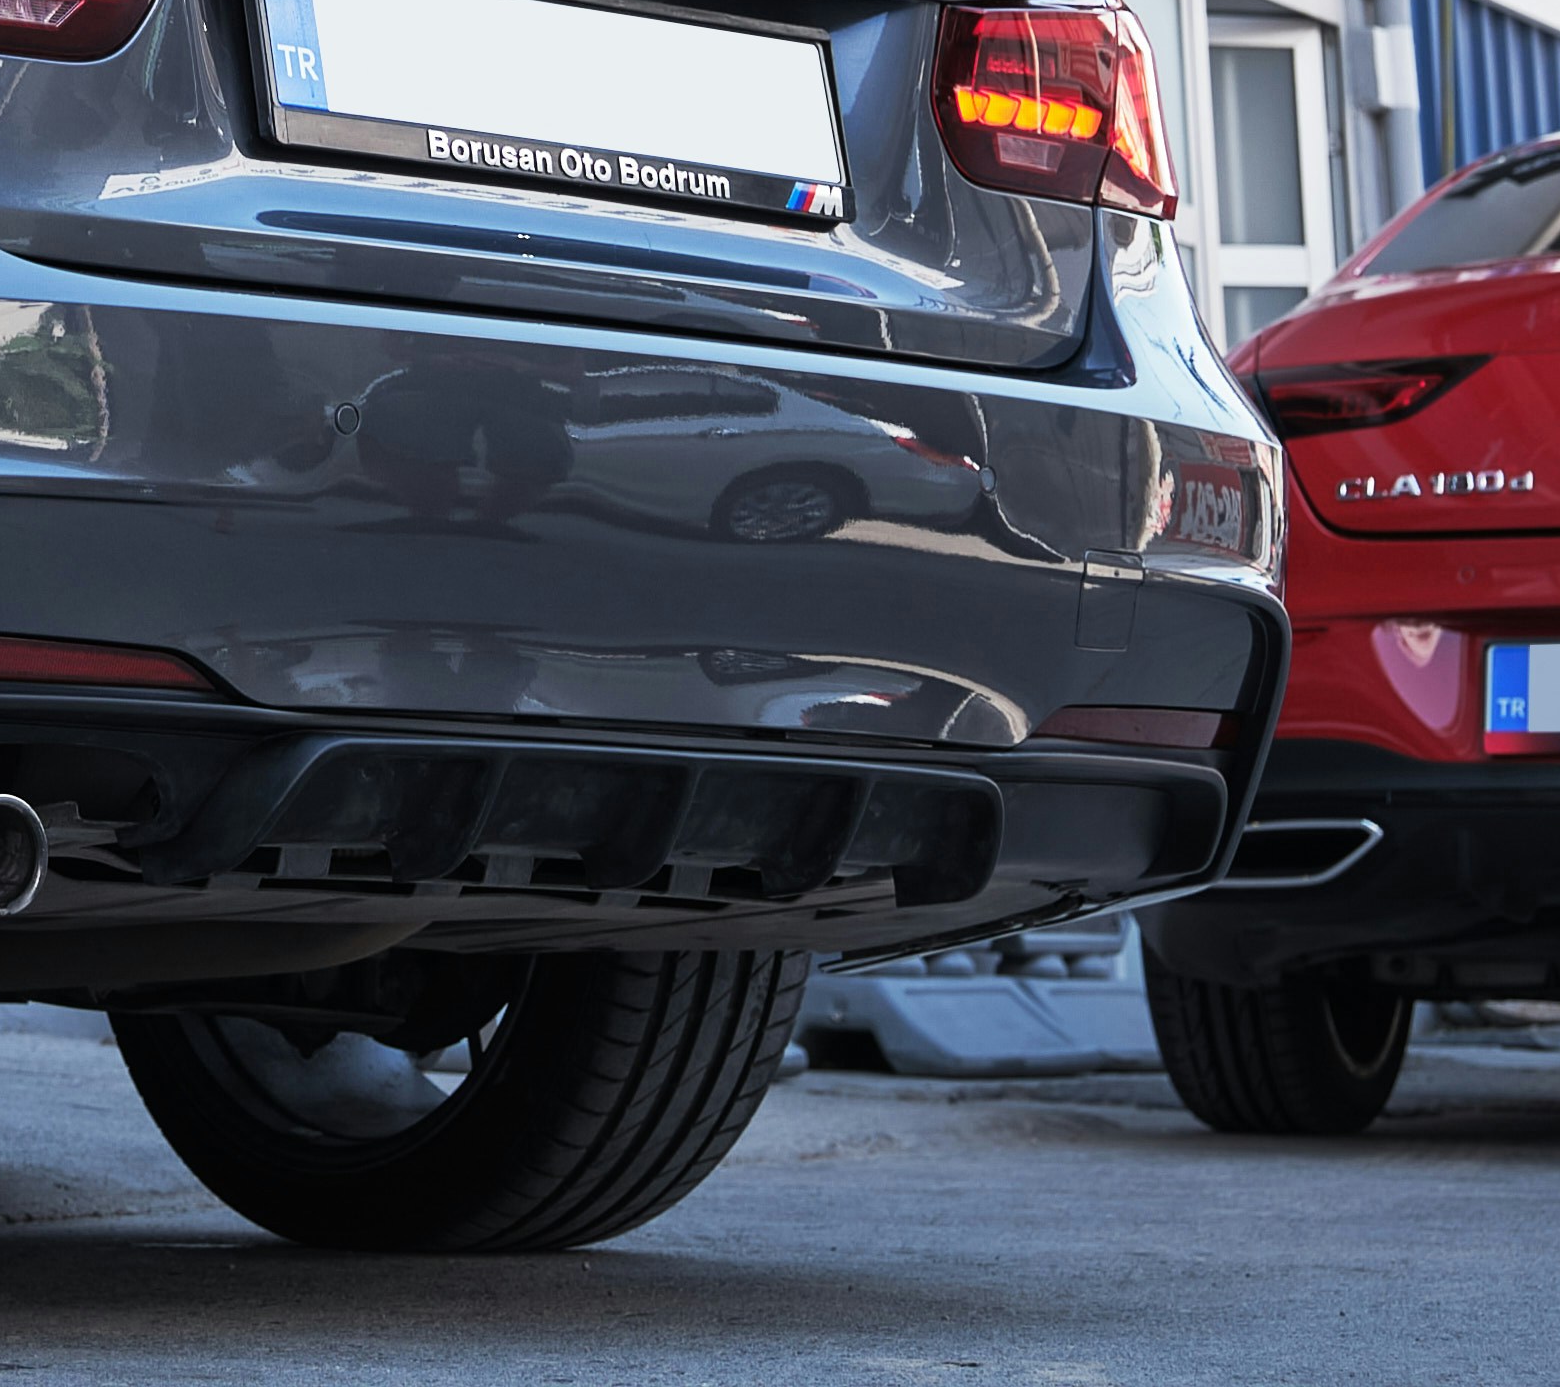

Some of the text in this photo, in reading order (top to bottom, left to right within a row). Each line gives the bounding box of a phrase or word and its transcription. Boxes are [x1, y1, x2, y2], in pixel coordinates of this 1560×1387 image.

[276, 42, 320, 82] TR
[426, 128, 732, 200] Borusan Oto Bodrum
[1336, 472, 1422, 501] CLA
[1496, 696, 1526, 718] TR
